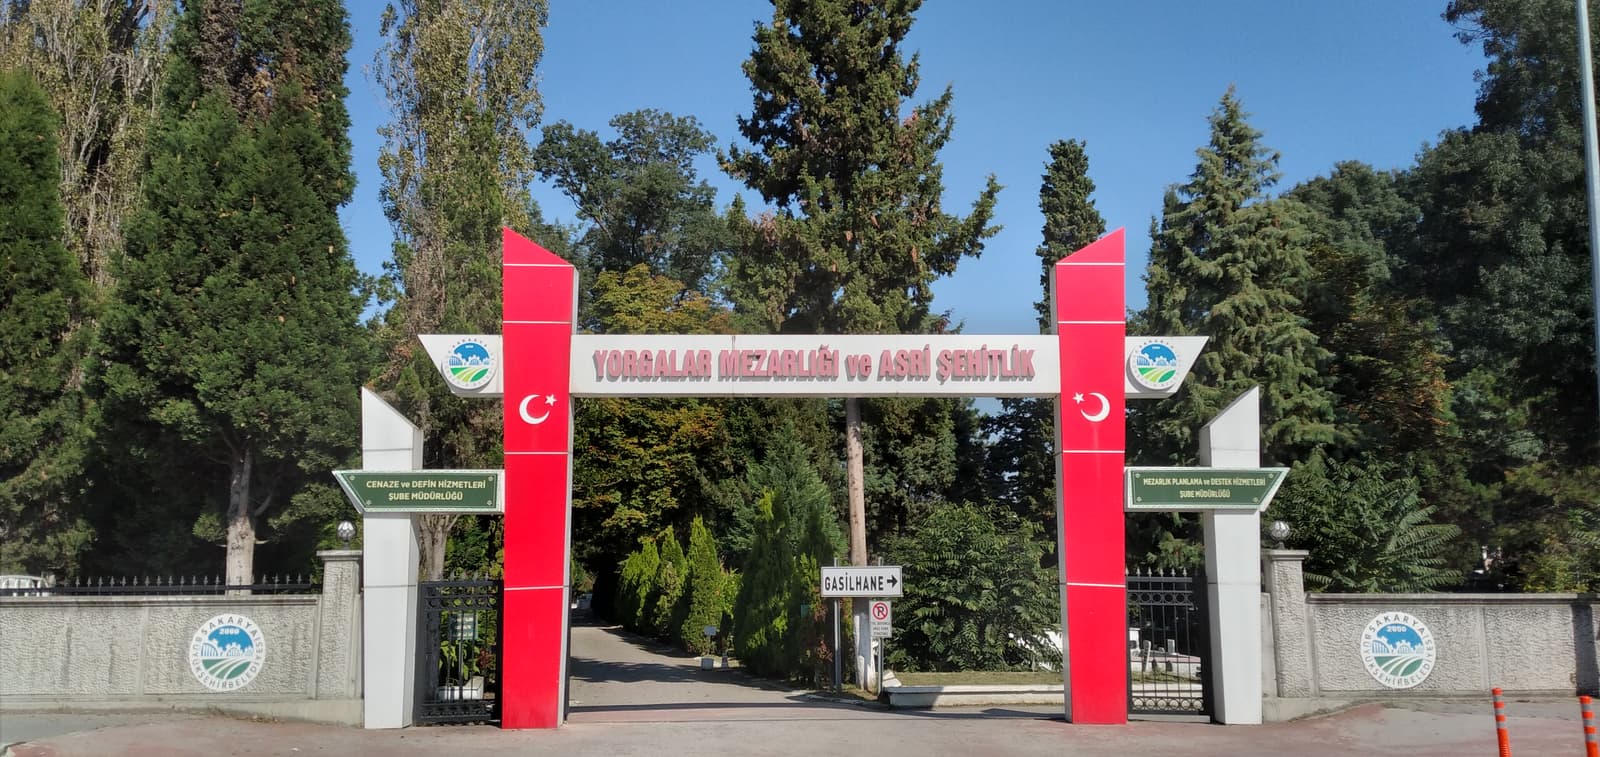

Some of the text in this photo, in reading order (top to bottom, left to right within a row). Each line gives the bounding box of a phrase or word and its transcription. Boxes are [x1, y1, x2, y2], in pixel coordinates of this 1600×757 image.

[593, 344, 1036, 385] YORGALAR MEZARLIĞI ve ASRİ ŞEHİTLİK
[366, 479, 486, 489] CENAZE ve DEFİN HİZMETLERİ
[1143, 478, 1172, 486] MEZARLIK
[1172, 478, 1202, 486] PLANLAMA
[1211, 478, 1232, 486] DESTEK
[1233, 477, 1266, 486] HİZMETLERİ
[388, 491, 464, 501] ŞUBE MÜDÜRLÜĞÜ
[1179, 489, 1231, 499] ŞUBE MÜDÜRLÜĞÜ
[824, 571, 885, 591] GASİLHANE
[201, 616, 258, 638] SAKARYA
[1369, 614, 1425, 635] SAKARYA
